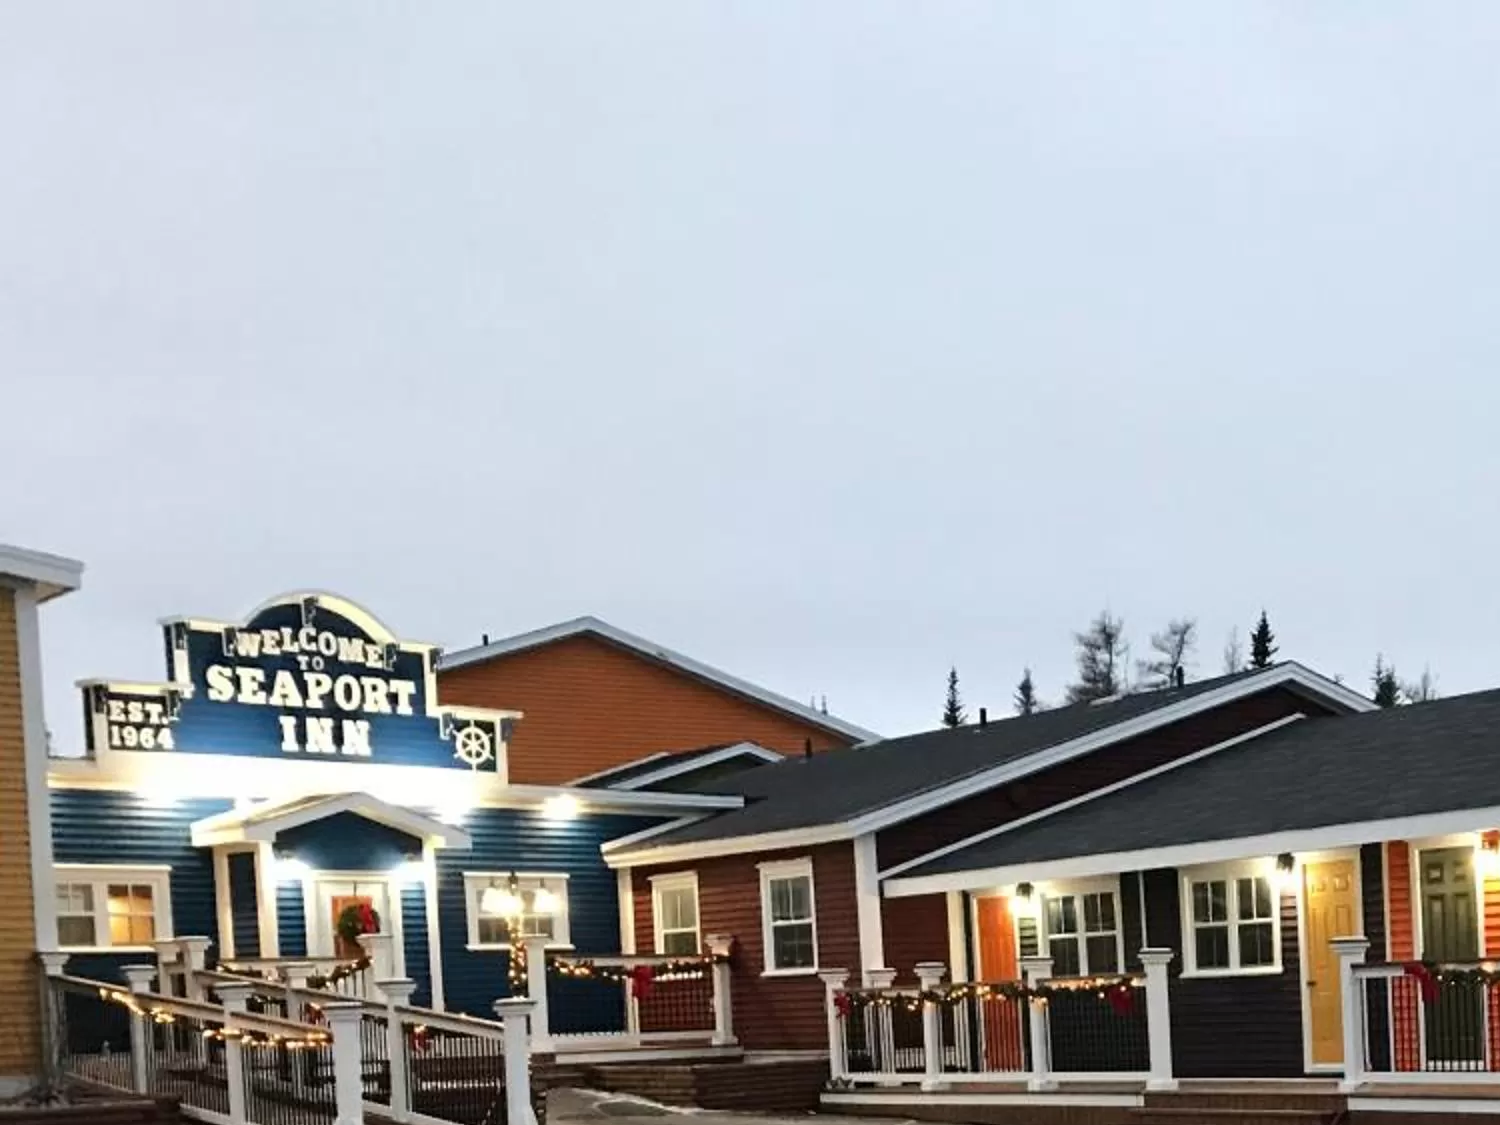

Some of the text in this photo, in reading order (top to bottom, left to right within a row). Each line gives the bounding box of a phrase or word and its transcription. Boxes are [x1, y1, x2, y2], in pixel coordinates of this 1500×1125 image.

[236, 627, 382, 668] WELCOME
[297, 656, 325, 670] TO
[206, 665, 416, 715] SEAPORT
[108, 700, 168, 725] EST.
[111, 725, 174, 749] 1964
[279, 716, 372, 756] INN
